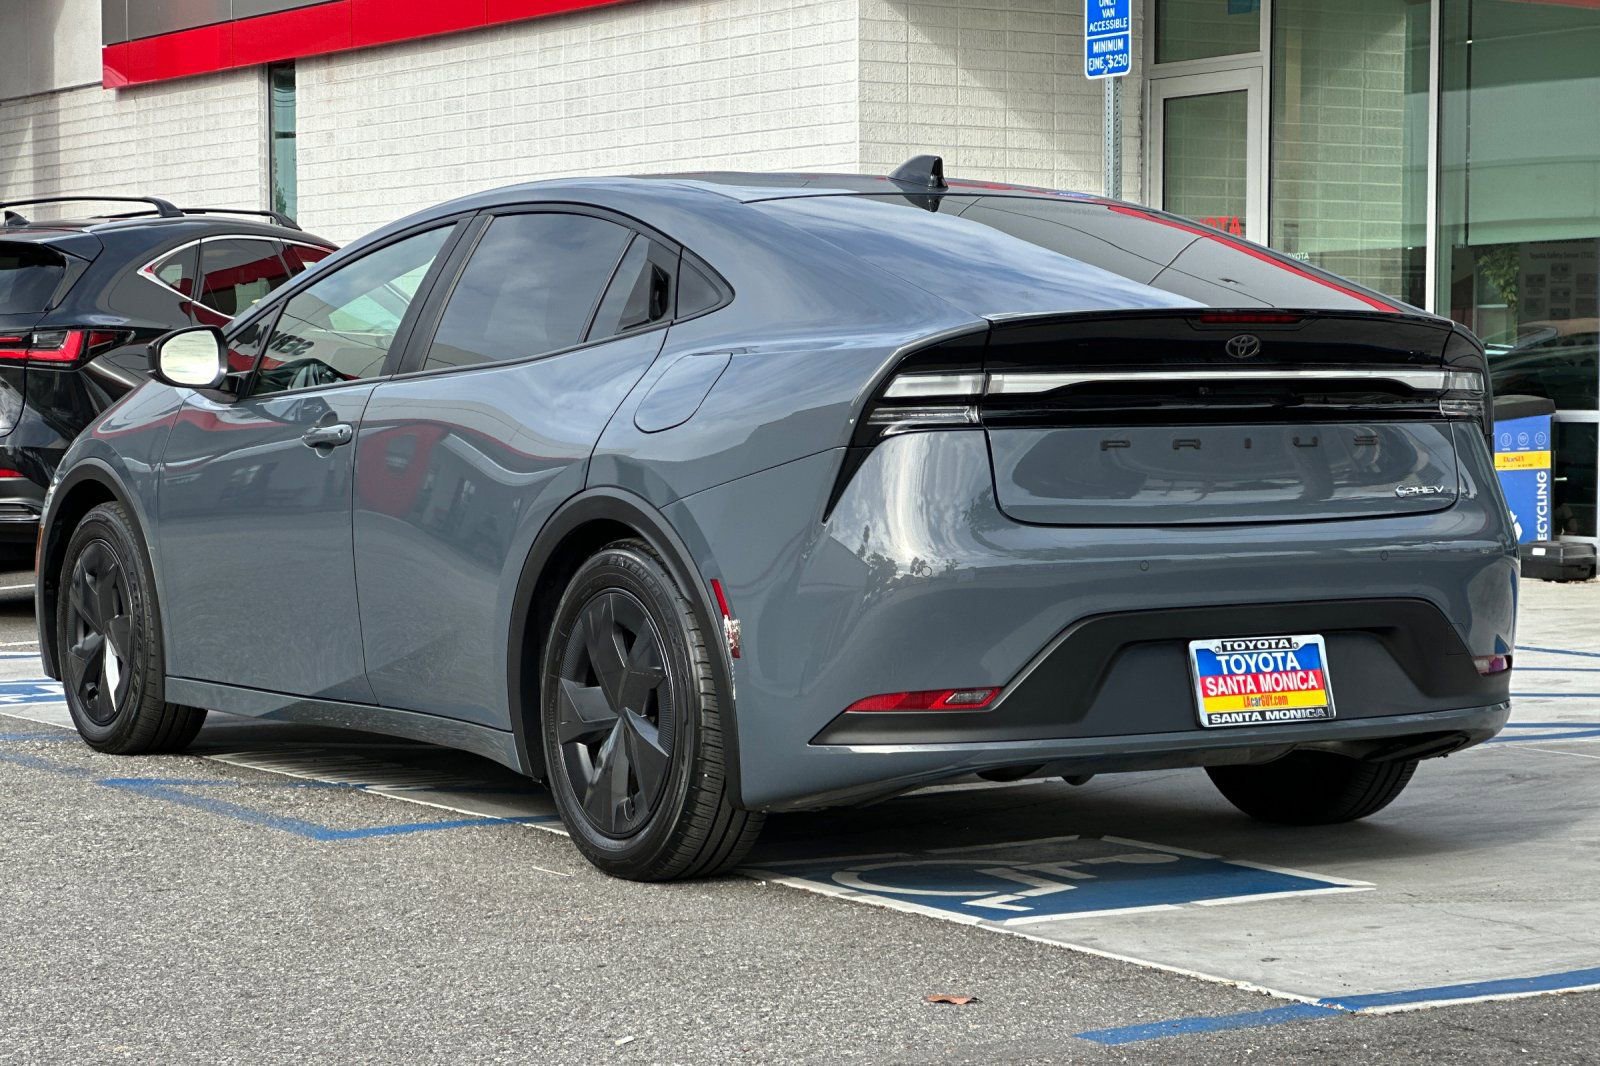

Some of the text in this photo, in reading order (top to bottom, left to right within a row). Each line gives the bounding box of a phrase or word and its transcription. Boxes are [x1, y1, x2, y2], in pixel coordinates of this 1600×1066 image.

[1101, 8, 1115, 18] VAN
[1088, 17, 1128, 32] ACCESSIBLE
[1093, 38, 1124, 54] MINIMUM
[1101, 436, 1378, 450] PRIUS
[1537, 470, 1548, 541] ECYCLING
[1224, 639, 1290, 651] TOYOTA
[1216, 652, 1301, 675] TOYOTA
[1206, 671, 1319, 697] SANTA MONICA
[1211, 707, 1326, 724] SANTA MONICA
